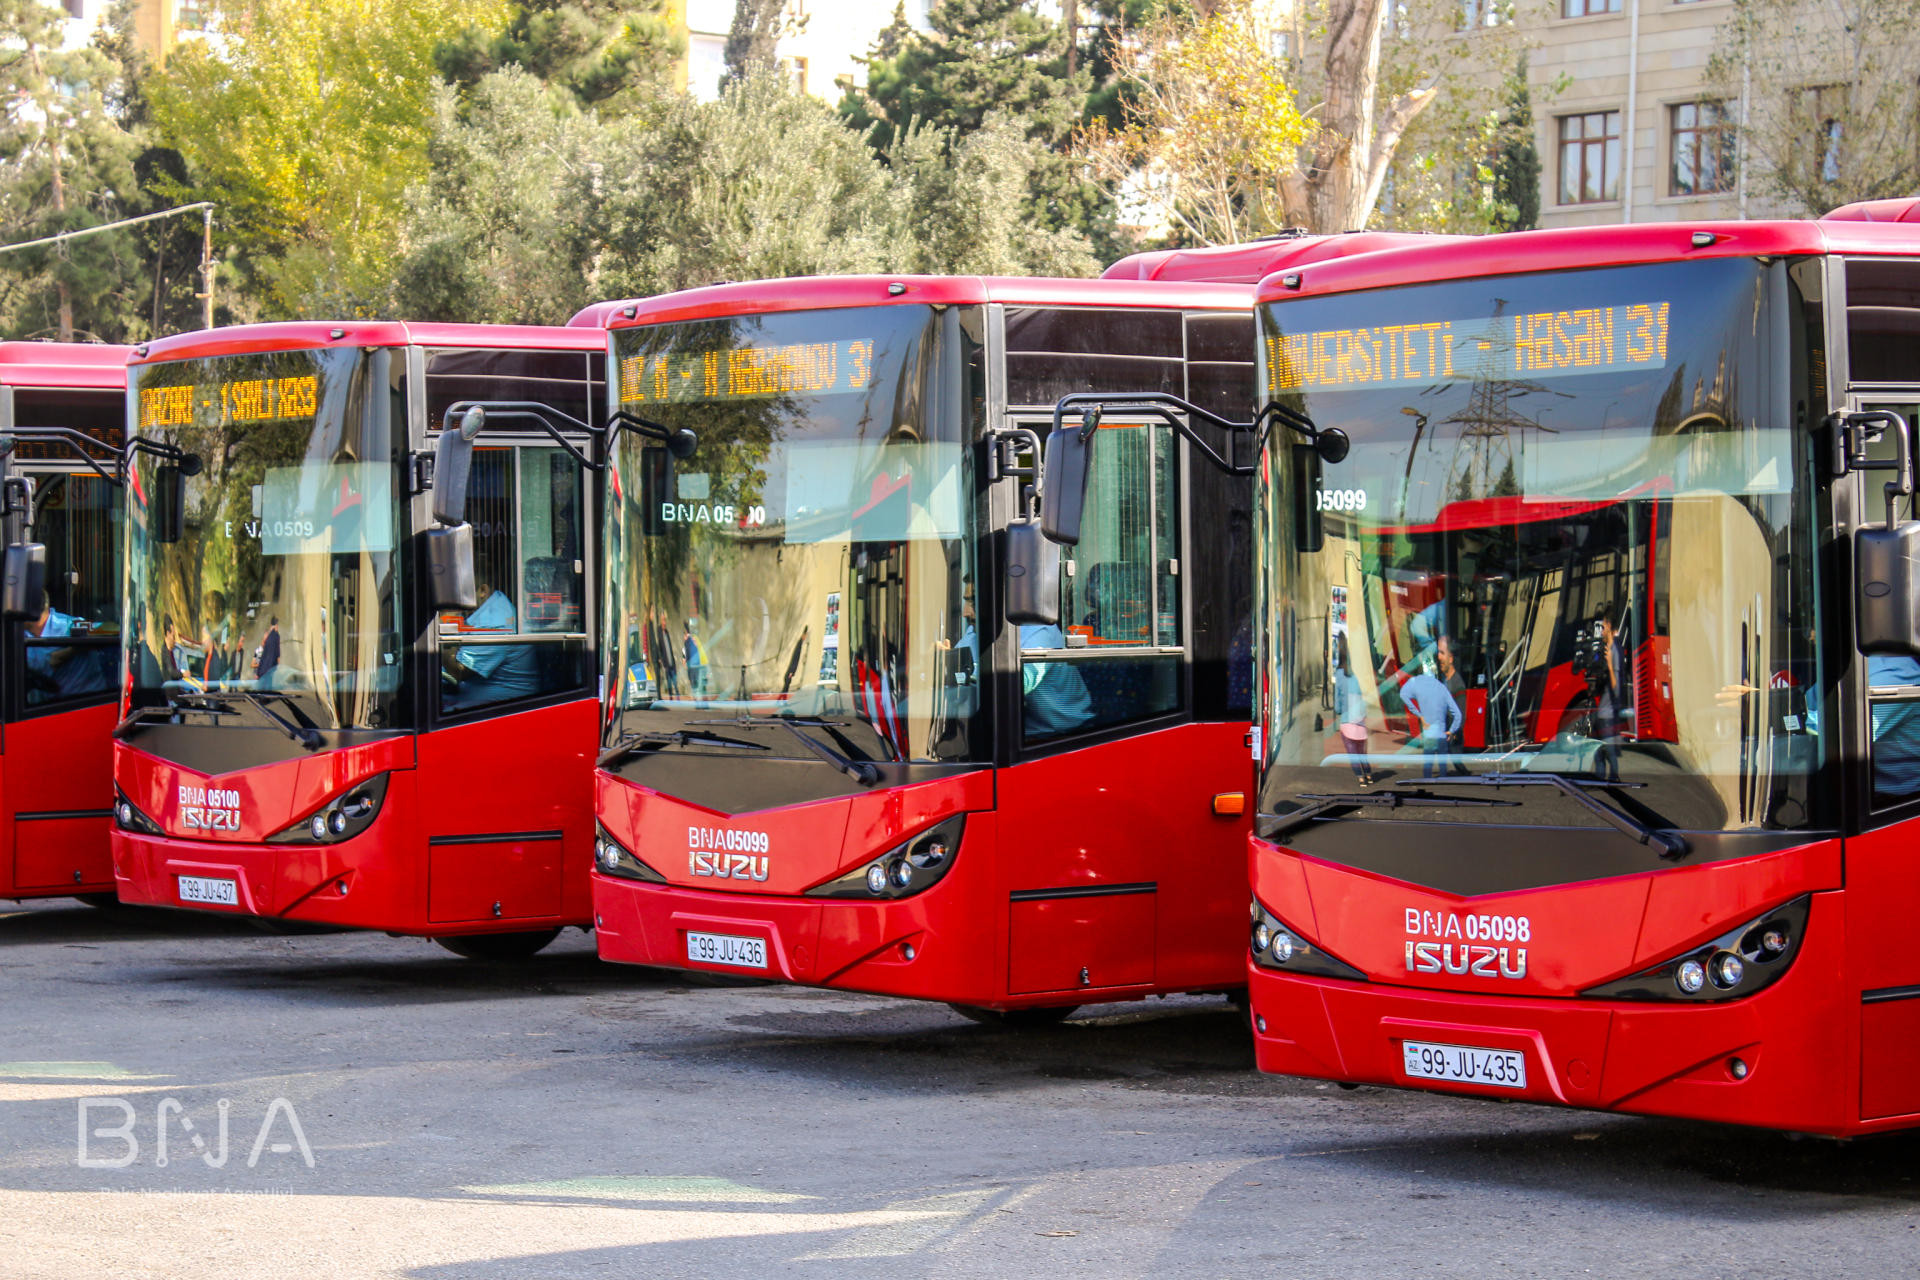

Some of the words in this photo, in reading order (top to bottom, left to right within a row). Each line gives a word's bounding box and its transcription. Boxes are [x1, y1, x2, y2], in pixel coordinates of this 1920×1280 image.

[662, 503, 711, 522] BNA
[179, 785, 206, 806] BNA
[208, 788, 240, 808] 05100
[181, 807, 241, 832] ISUZU
[688, 851, 769, 882] ISUZU
[1405, 907, 1462, 939] BNA
[1466, 914, 1531, 943] 05098
[1405, 941, 1527, 979] ISUZU
